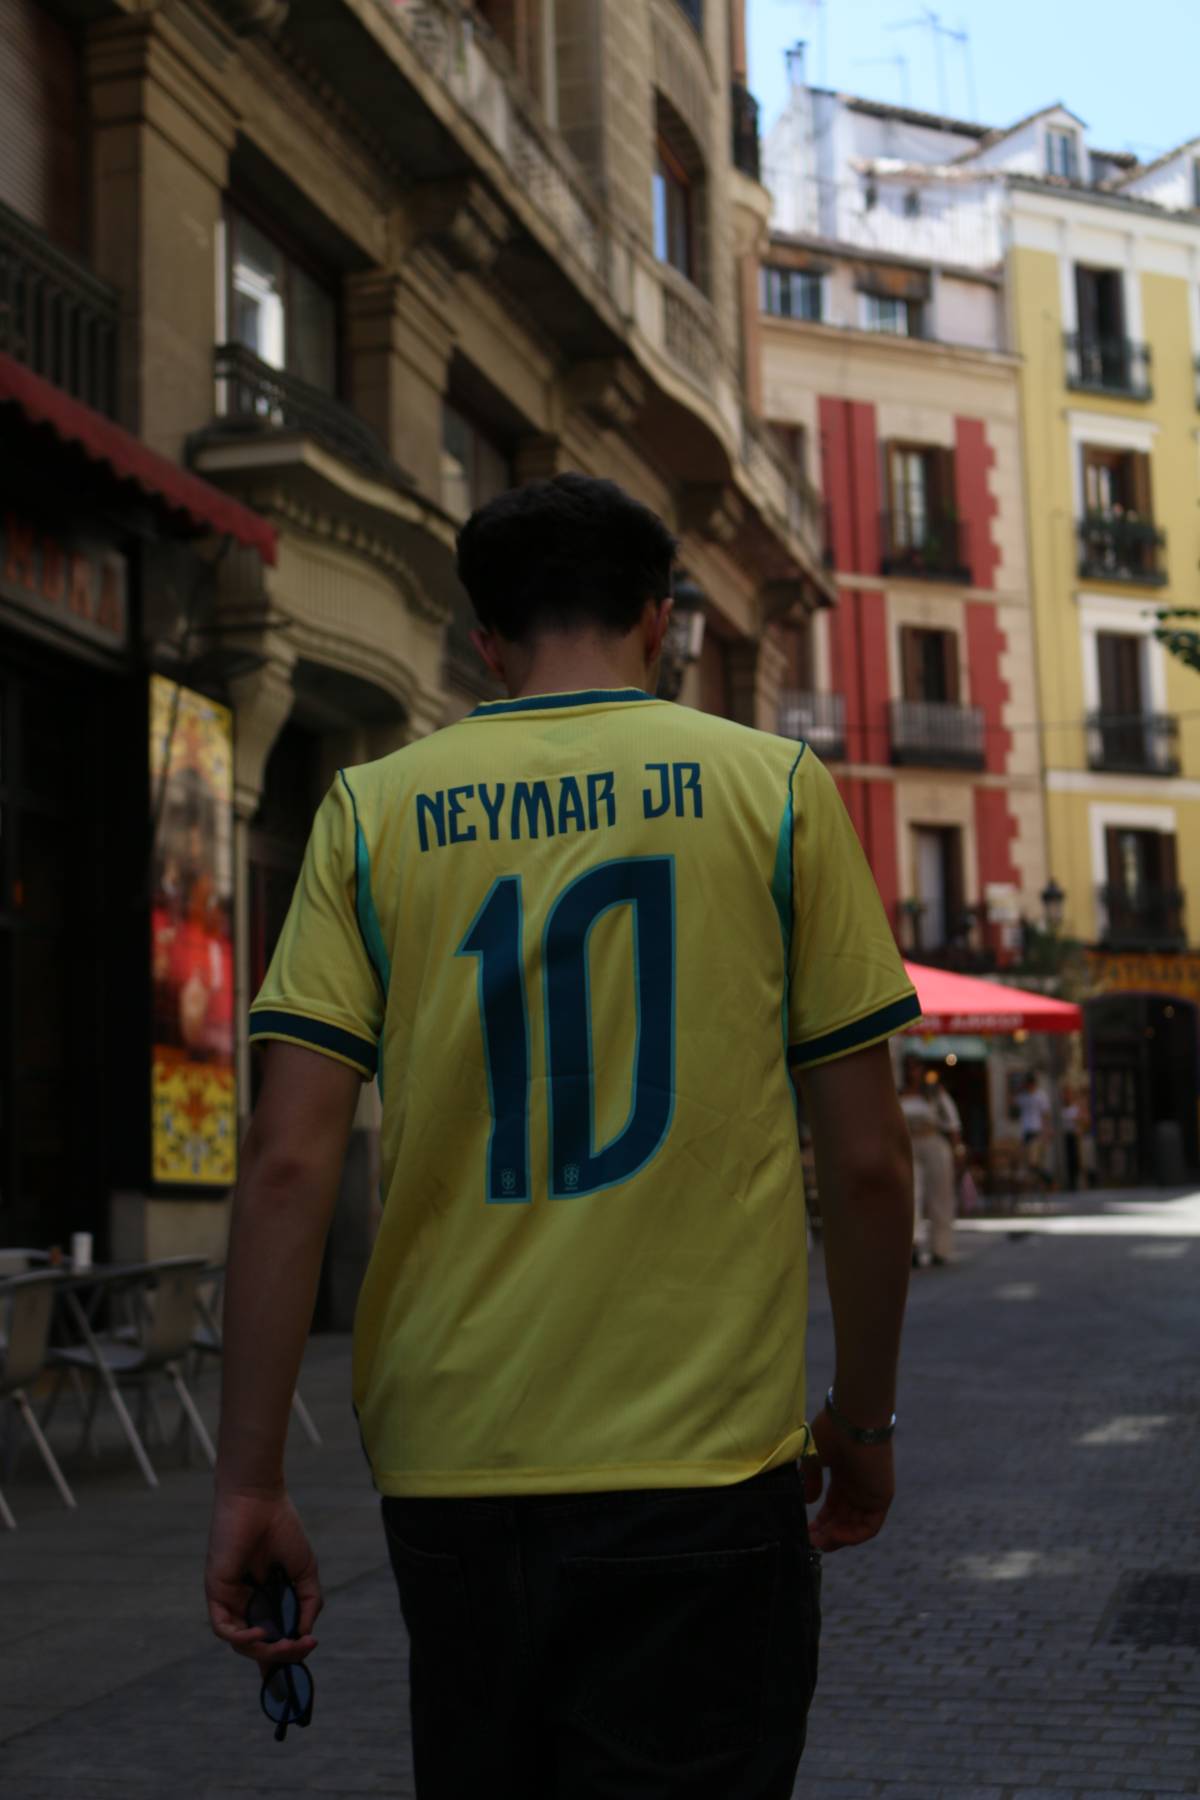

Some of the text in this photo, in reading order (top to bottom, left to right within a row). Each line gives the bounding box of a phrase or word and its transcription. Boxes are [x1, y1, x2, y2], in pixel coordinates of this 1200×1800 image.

[416, 762, 703, 852] NEYMAR JR
[454, 854, 676, 1204] 10
